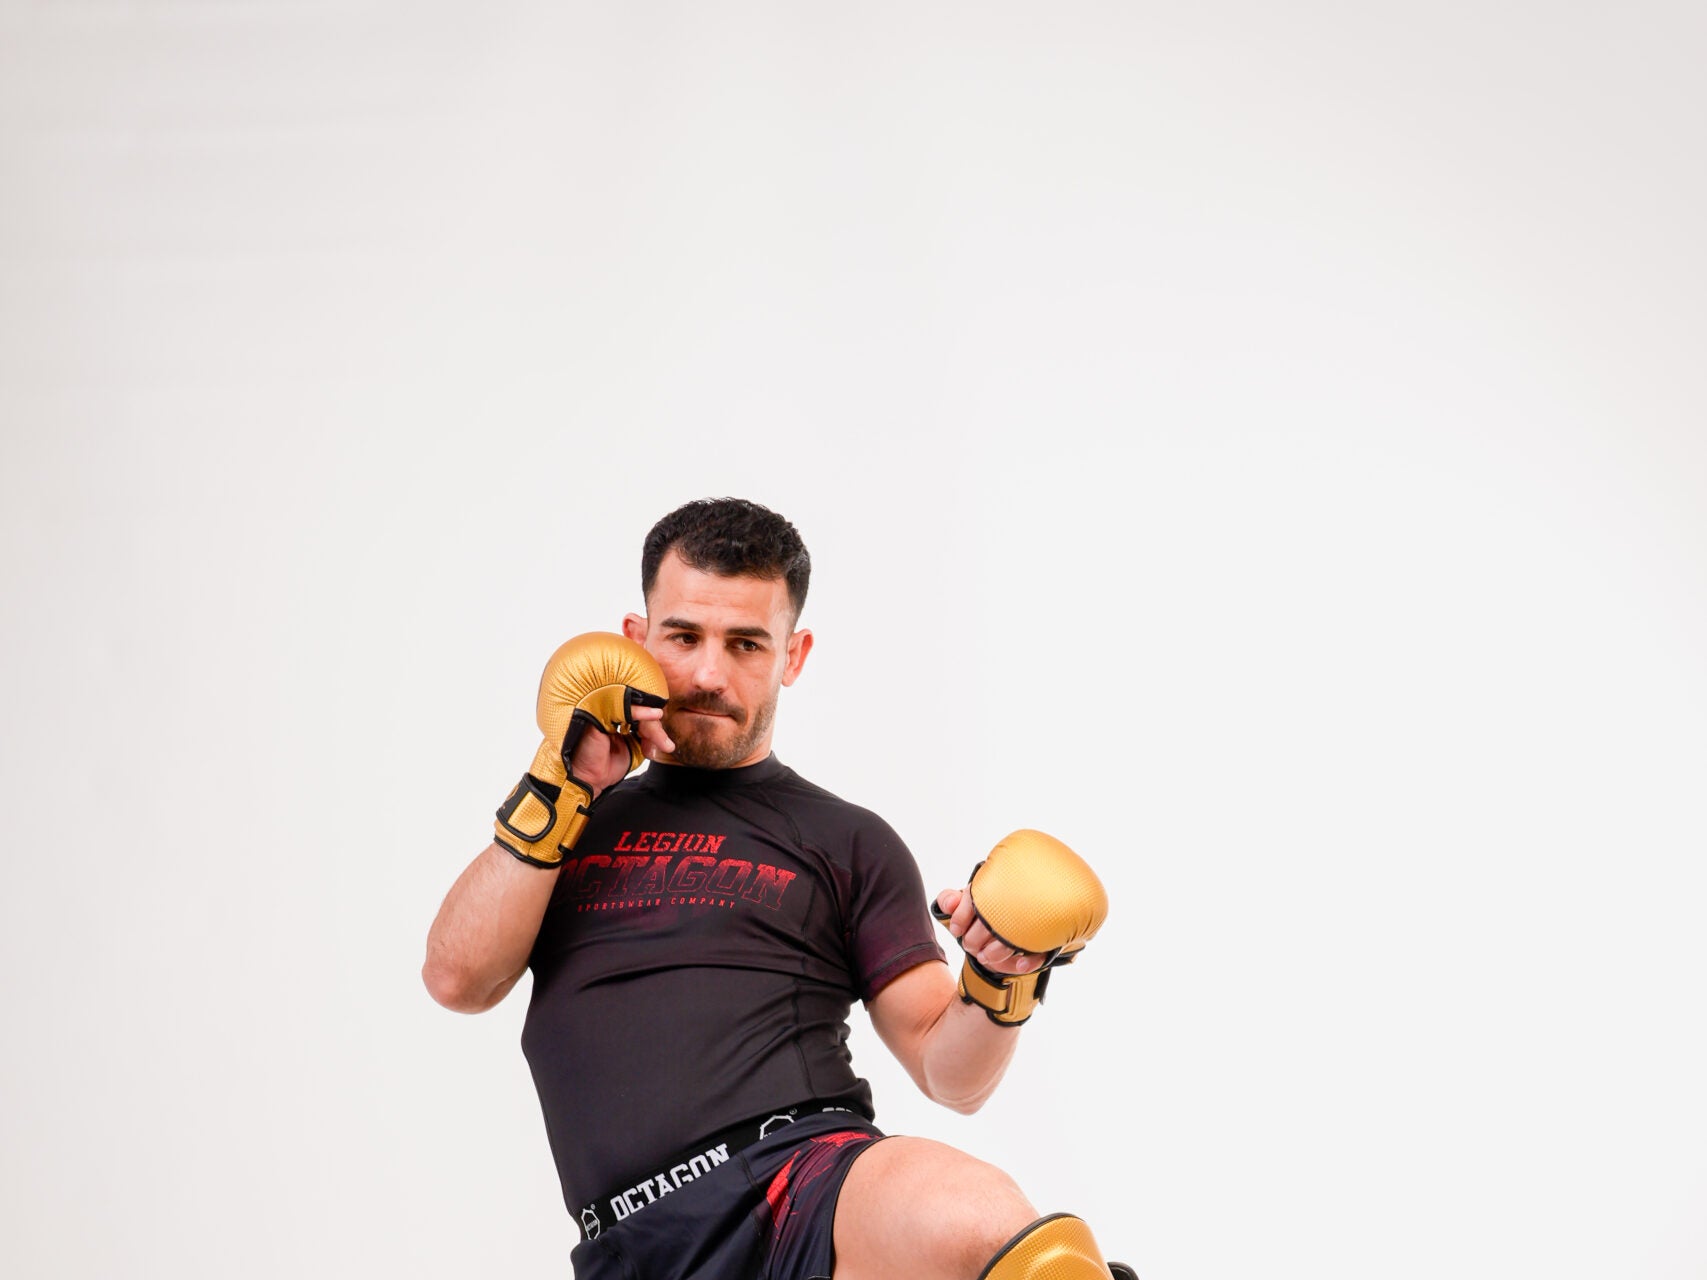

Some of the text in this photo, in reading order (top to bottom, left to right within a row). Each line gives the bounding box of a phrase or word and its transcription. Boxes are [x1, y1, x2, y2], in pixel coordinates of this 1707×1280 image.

[614, 831, 726, 853] LEGION
[577, 897, 736, 912] SPORTSWEAR COMPANY
